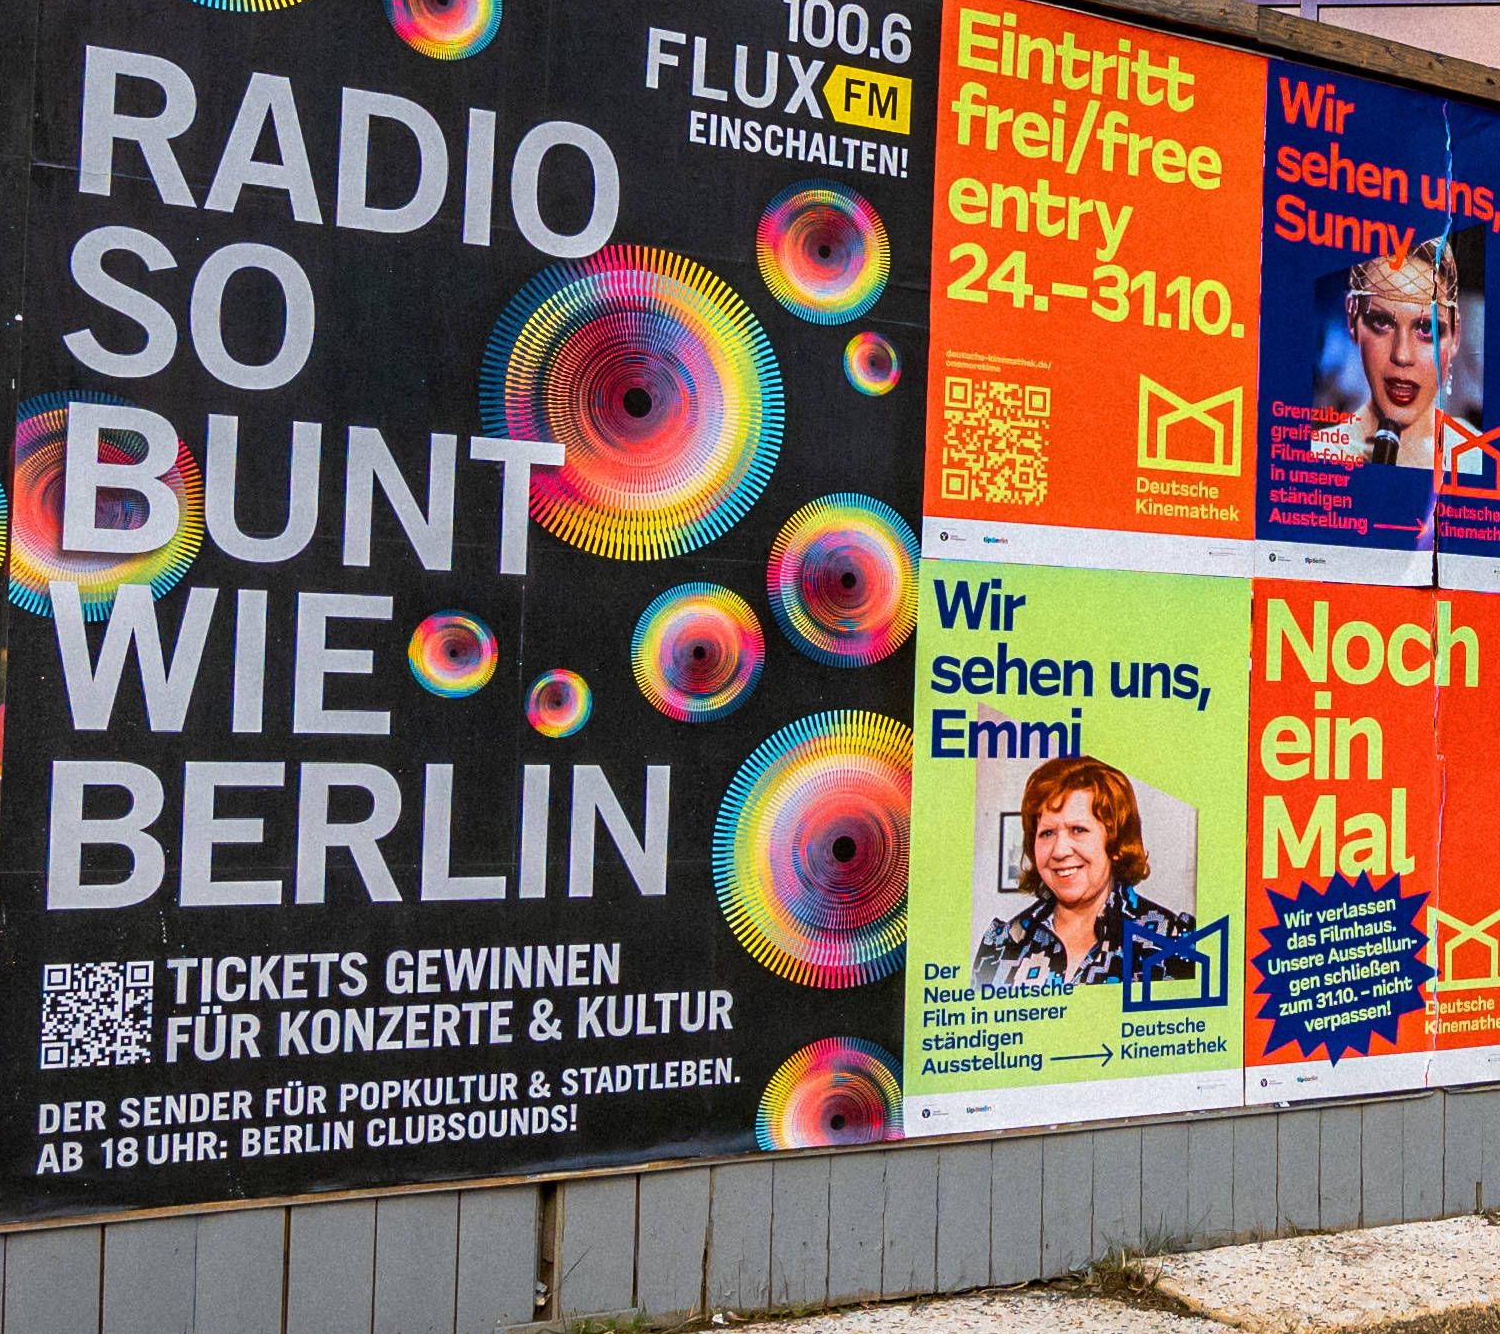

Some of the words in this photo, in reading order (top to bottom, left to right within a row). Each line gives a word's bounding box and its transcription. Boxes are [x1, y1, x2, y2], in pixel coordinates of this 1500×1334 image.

[645, 26, 826, 119] FLUX
[844, 82, 900, 122] FM
[958, 7, 1195, 112] Eintritt
[1279, 77, 1355, 135] Wir
[78, 45, 620, 258] RADIO
[688, 110, 910, 178] EINSCHALTEN!
[952, 81, 1222, 190] frei/free
[1276, 141, 1408, 204] sehen
[948, 177, 1133, 263] entry
[1274, 194, 1415, 272] Sunny
[62, 226, 316, 390] SO
[1271, 424, 1350, 445] greifende
[1272, 401, 1362, 425] Grenzüber-
[1270, 464, 1284, 481] in
[1289, 468, 1350, 487] unserer
[1271, 443, 1364, 471] Filmerfolge
[62, 402, 565, 576] BUNT
[1136, 477, 1219, 499] Deutsche
[1136, 499, 1240, 521] Kinemathek
[1270, 486, 1352, 511] ständigen
[1269, 507, 1368, 535] Ausstellung
[933, 578, 1026, 631] Wir
[48, 579, 394, 736] WIE
[1266, 598, 1480, 687] Noch
[931, 643, 1094, 696] sehen
[1110, 661, 1211, 711] uns,
[931, 708, 1082, 758] Emmi
[1260, 691, 1383, 781] ein
[45, 761, 672, 912] BERLIN
[1262, 787, 1415, 880] Mal
[1284, 909, 1312, 929] Wir
[1316, 898, 1396, 923] verlassen
[1287, 932, 1316, 950] das
[1320, 920, 1396, 945] Filmhaus.
[166, 951, 367, 1006] TICKETS
[386, 943, 621, 994] GEWINNEN
[924, 963, 960, 981] Der
[1268, 955, 1324, 975] Unsere
[1328, 938, 1418, 965] Ausstellun-
[1289, 977, 1320, 997] gen
[1324, 959, 1400, 987] schließen
[924, 985, 975, 1003] Neue
[981, 980, 1074, 1000] Deutsche
[1279, 999, 1312, 1016] zum
[1316, 989, 1358, 1009] 31.10.
[1372, 977, 1412, 997] nicht
[166, 1007, 259, 1065] FÜR
[279, 997, 512, 1058] KONZERTE
[529, 998, 561, 1040] &
[577, 990, 734, 1034] KULTUR
[923, 1007, 965, 1028] Film
[971, 1006, 987, 1023] in
[993, 1004, 1067, 1022] unserer
[1121, 1018, 1205, 1038] Deutsche
[1304, 1001, 1391, 1033] verpassen!
[921, 1029, 1023, 1052] ständigen
[1121, 1037, 1227, 1060] Kinemathek
[921, 1052, 1043, 1075] Ausstellung
